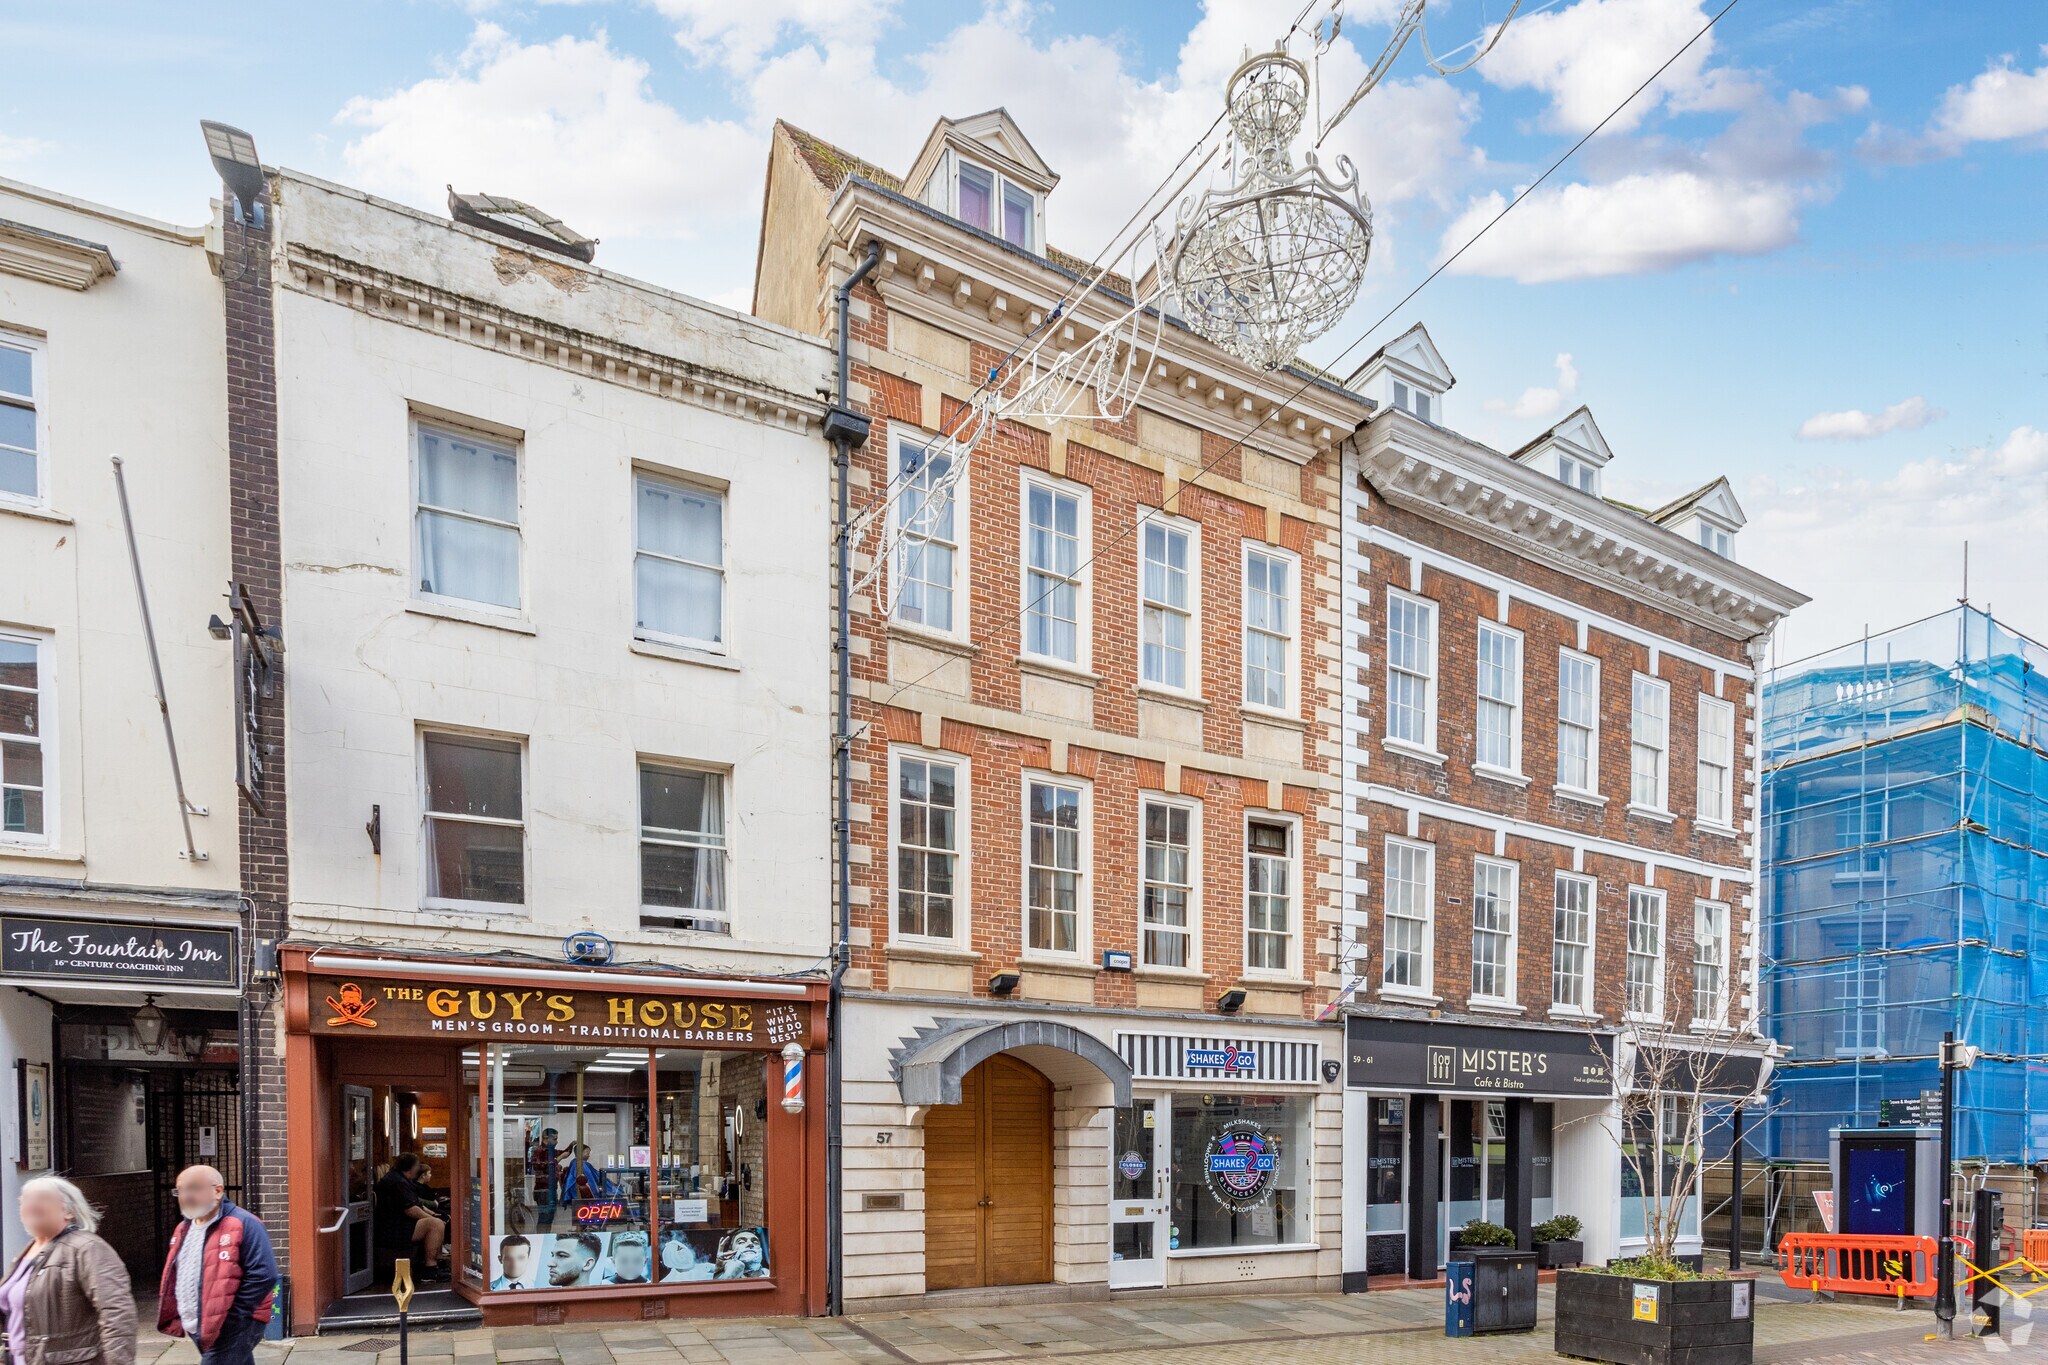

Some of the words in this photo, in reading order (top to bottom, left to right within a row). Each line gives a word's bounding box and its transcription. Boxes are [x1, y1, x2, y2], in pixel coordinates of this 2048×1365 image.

[11, 928, 63, 953] The
[67, 935, 175, 960] Fountain
[178, 940, 223, 962] Inn
[70, 960, 114, 969] CENTURY
[115, 963, 165, 971] COACHING
[383, 987, 424, 1000] THE
[426, 989, 576, 1022] GUY'S
[607, 998, 753, 1031] HOUSE
[766, 1013, 798, 1026] WHAT
[431, 1019, 486, 1032] MEN'S
[492, 1022, 553, 1034] GROOM
[569, 1025, 680, 1039] TRADITIONAL
[685, 1030, 753, 1042] BARBERS
[767, 1025, 784, 1035] WE
[786, 1021, 802, 1031] DO
[1190, 1053, 1225, 1065] SHAKES
[1225, 1046, 1238, 1071] 2
[1238, 1055, 1252, 1066] GO
[1353, 1055, 1361, 1063] 59
[1366, 1056, 1373, 1064] 61
[1462, 1048, 1547, 1075] MISTER'S
[1474, 1076, 1493, 1088] Cafe
[1494, 1077, 1501, 1088] &
[1503, 1078, 1525, 1089] Bistro
[1223, 1119, 1262, 1130] MILKSHAKES
[876, 1132, 893, 1144] 57
[1203, 1142, 1214, 1184] SMOOTHIES
[1214, 1158, 1245, 1168] SHAKES
[1245, 1150, 1258, 1174] 2
[1258, 1158, 1271, 1168] GO
[1219, 1175, 1266, 1197] GLOUCESTER
[1211, 1190, 1231, 1209] FRO-YO
[577, 1205, 622, 1219] OPEN
[1237, 1203, 1260, 1213] COFFEE
